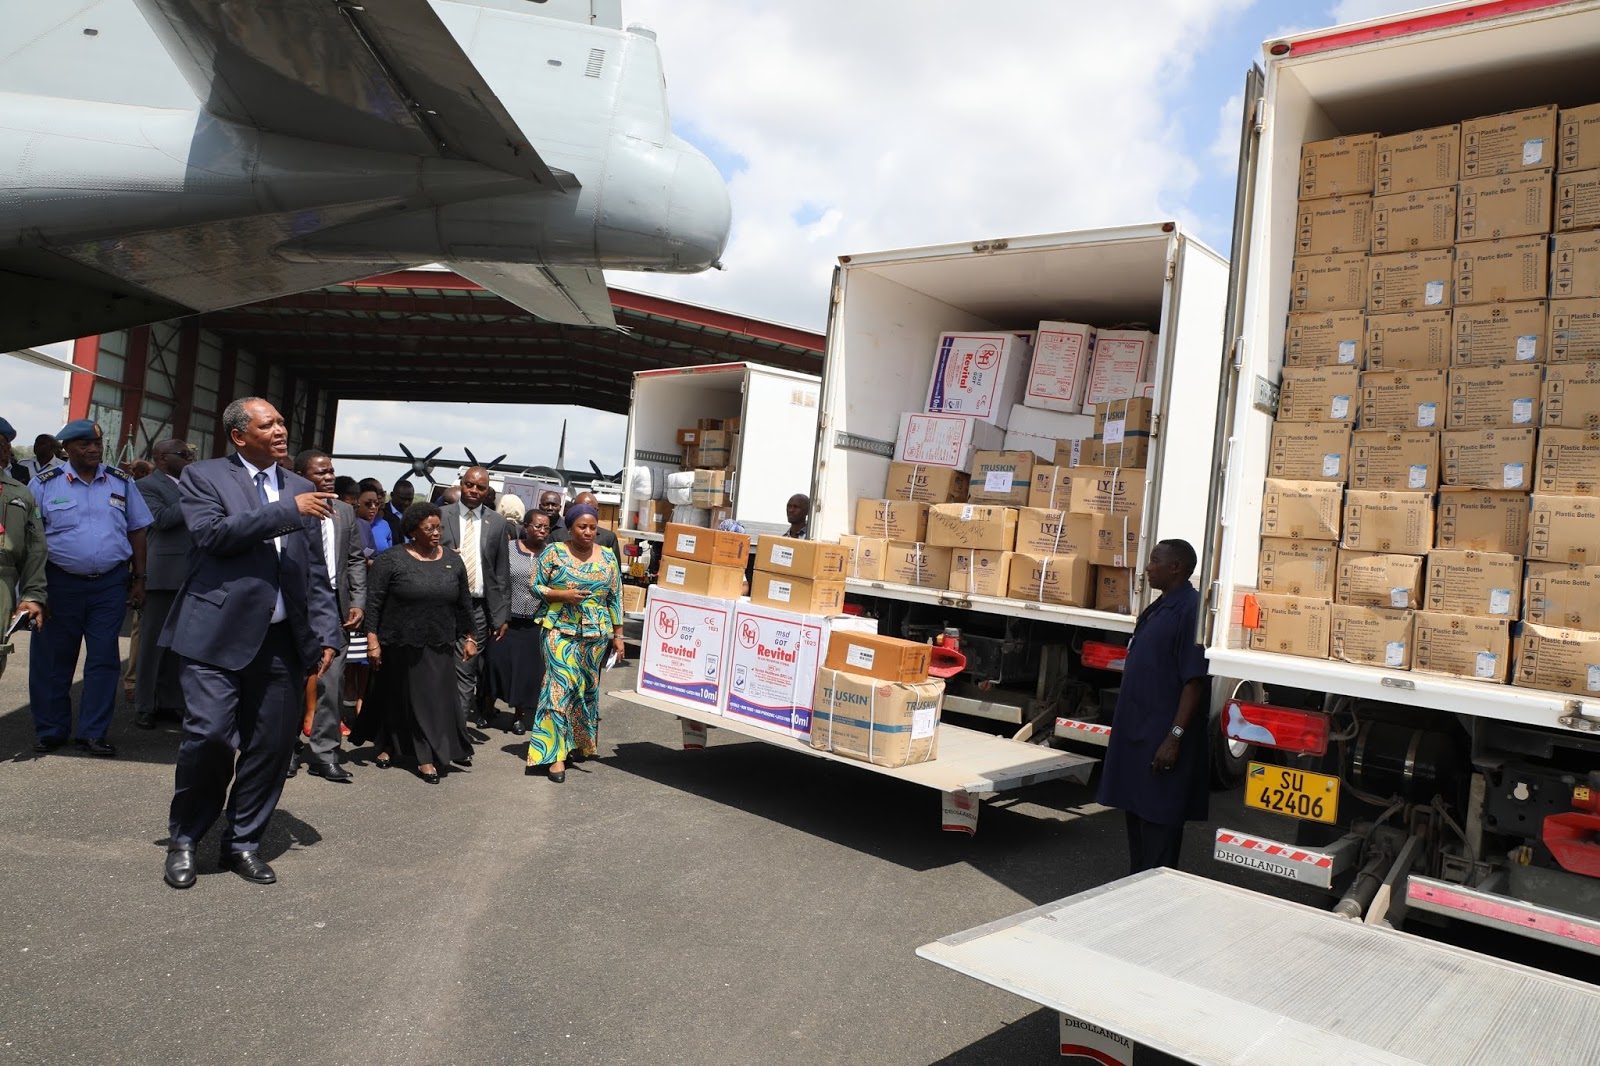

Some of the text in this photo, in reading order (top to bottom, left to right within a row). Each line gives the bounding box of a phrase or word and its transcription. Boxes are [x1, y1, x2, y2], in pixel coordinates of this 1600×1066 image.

[960, 354, 973, 388] Revital
[932, 395, 940, 411] 10ml
[1041, 523, 1067, 534] LYFE
[704, 617, 715, 625] CE
[776, 630, 790, 638] msd
[662, 642, 696, 658] Revital
[758, 644, 796, 663] Revital
[701, 688, 717, 701] 10ml
[824, 688, 868, 706] TRUSKIN
[1280, 771, 1304, 792] SU
[1260, 787, 1323, 818] 42406
[1216, 850, 1296, 878] DHOLLANDIA
[1065, 1019, 1130, 1048] DHOLLANDIA
